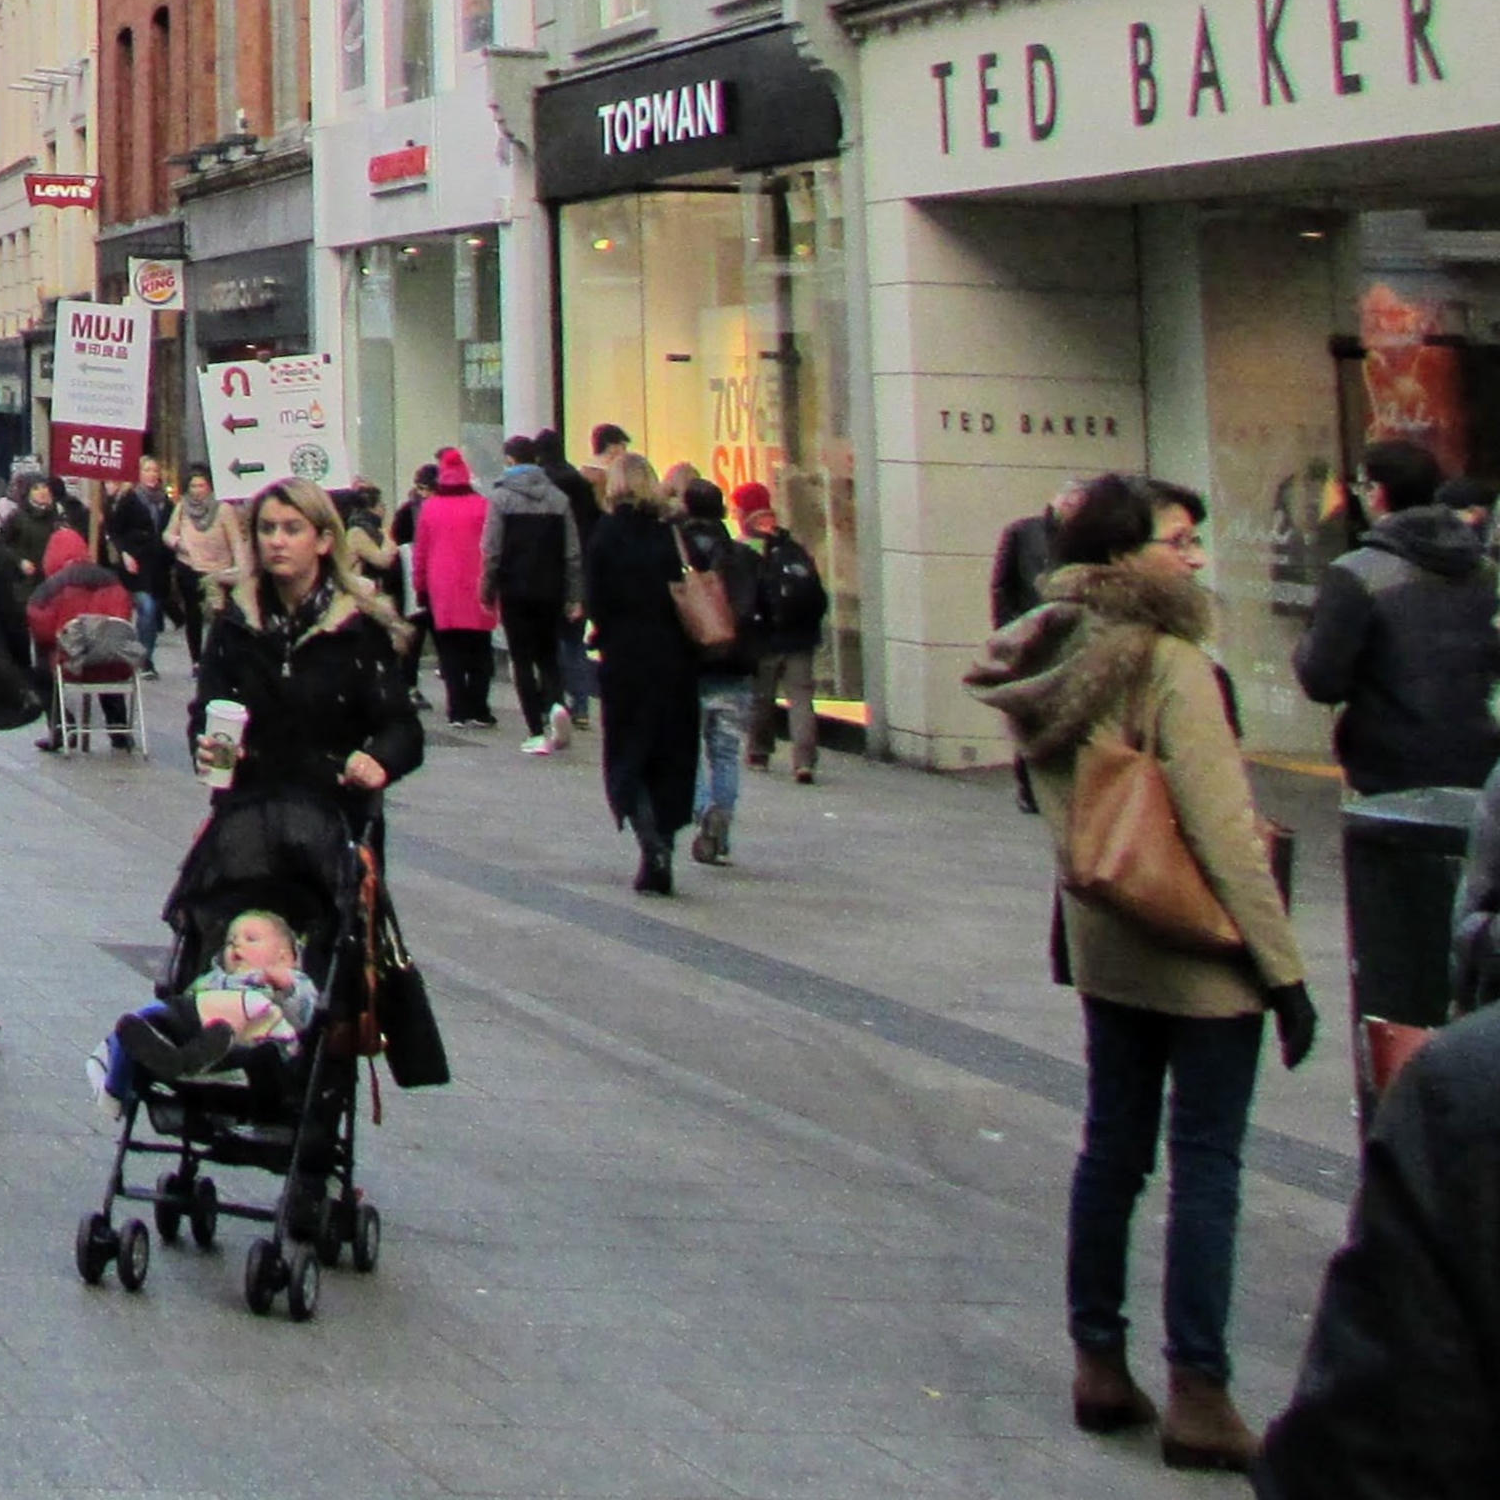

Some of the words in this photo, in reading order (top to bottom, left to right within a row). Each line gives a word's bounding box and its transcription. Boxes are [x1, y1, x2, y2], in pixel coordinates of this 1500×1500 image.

[931, 43, 1059, 154] TED
[598, 80, 725, 155] TOPMAN
[141, 276, 175, 295] KING
[71, 312, 135, 344] MUJI
[939, 409, 996, 434] TED
[1019, 412, 1118, 437] BAKER
[70, 435, 124, 458] SALE
[69, 453, 98, 466] NOW
[100, 457, 123, 470] ON!
